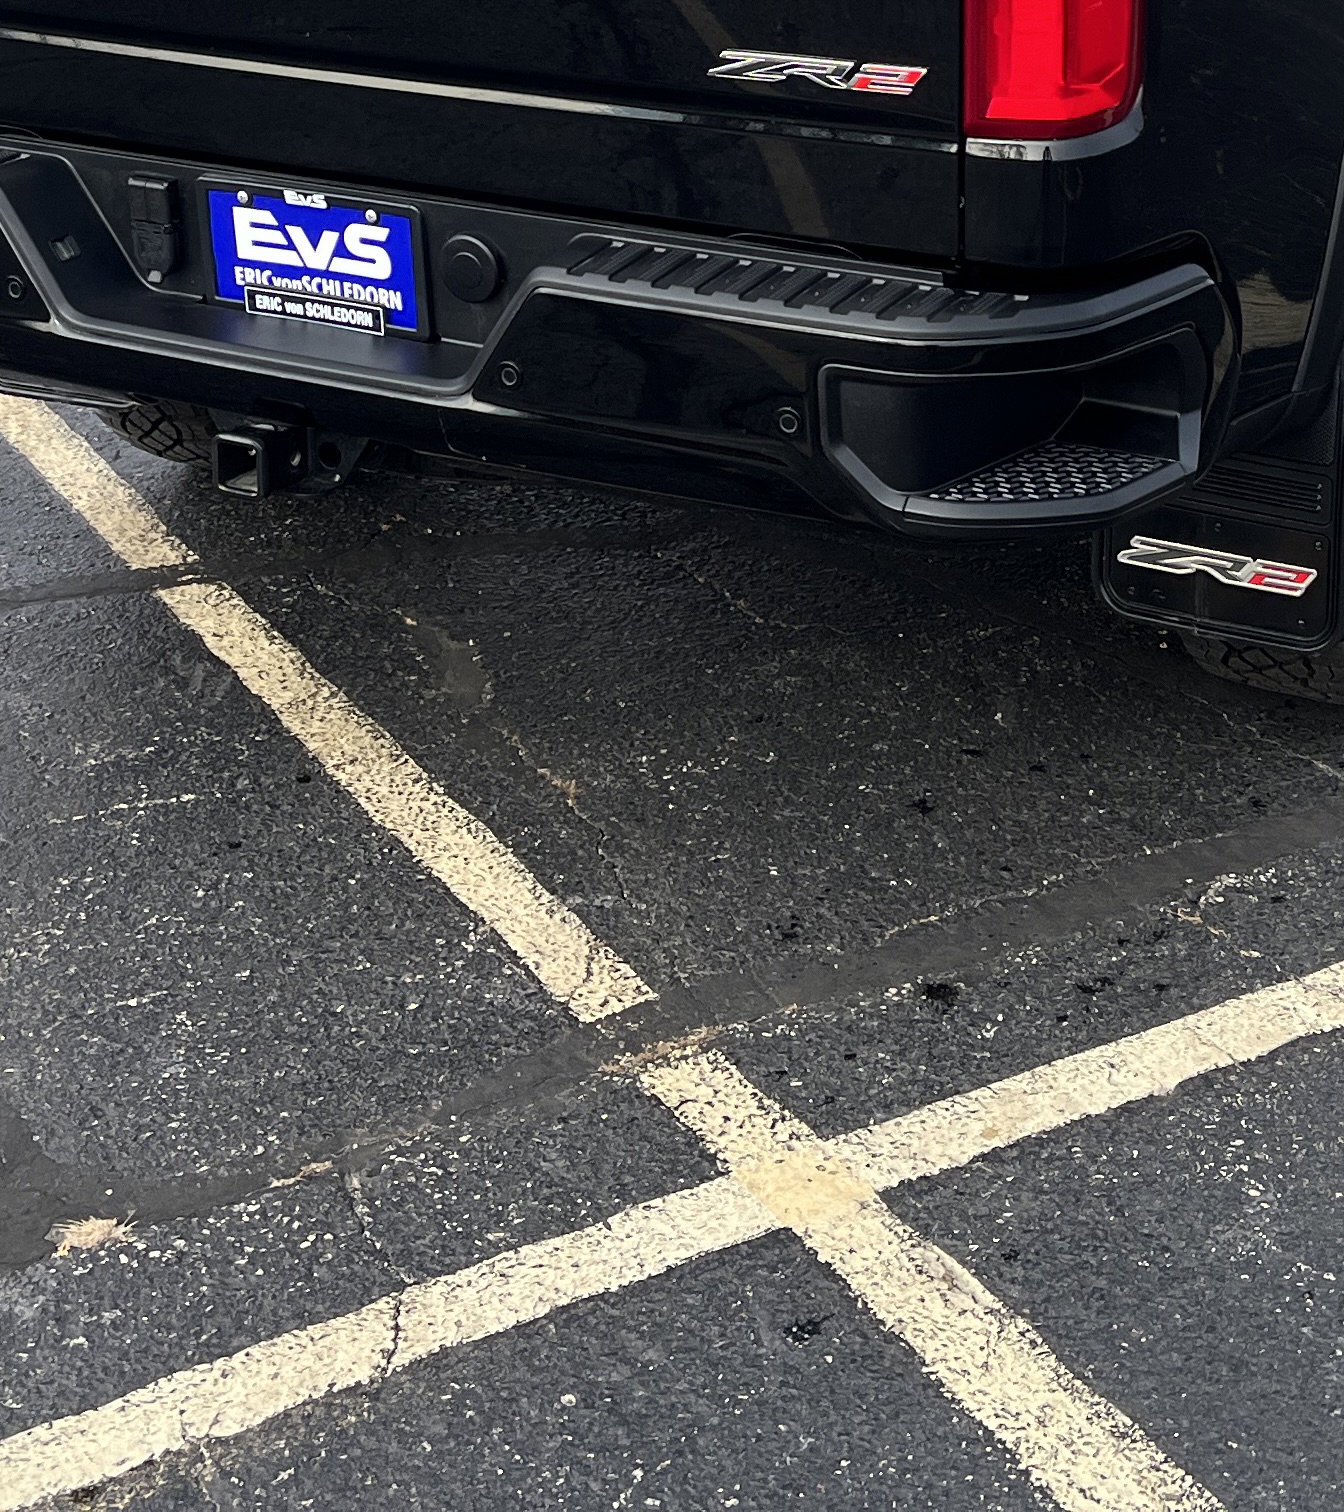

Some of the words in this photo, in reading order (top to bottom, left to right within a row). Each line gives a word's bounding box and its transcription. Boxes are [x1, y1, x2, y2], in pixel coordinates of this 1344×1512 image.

[706, 49, 929, 95] ZR2
[254, 294, 283, 312] ERIC
[284, 301, 305, 316] von
[304, 301, 374, 328] SCHLEDORN
[1117, 535, 1318, 597] ZR2
